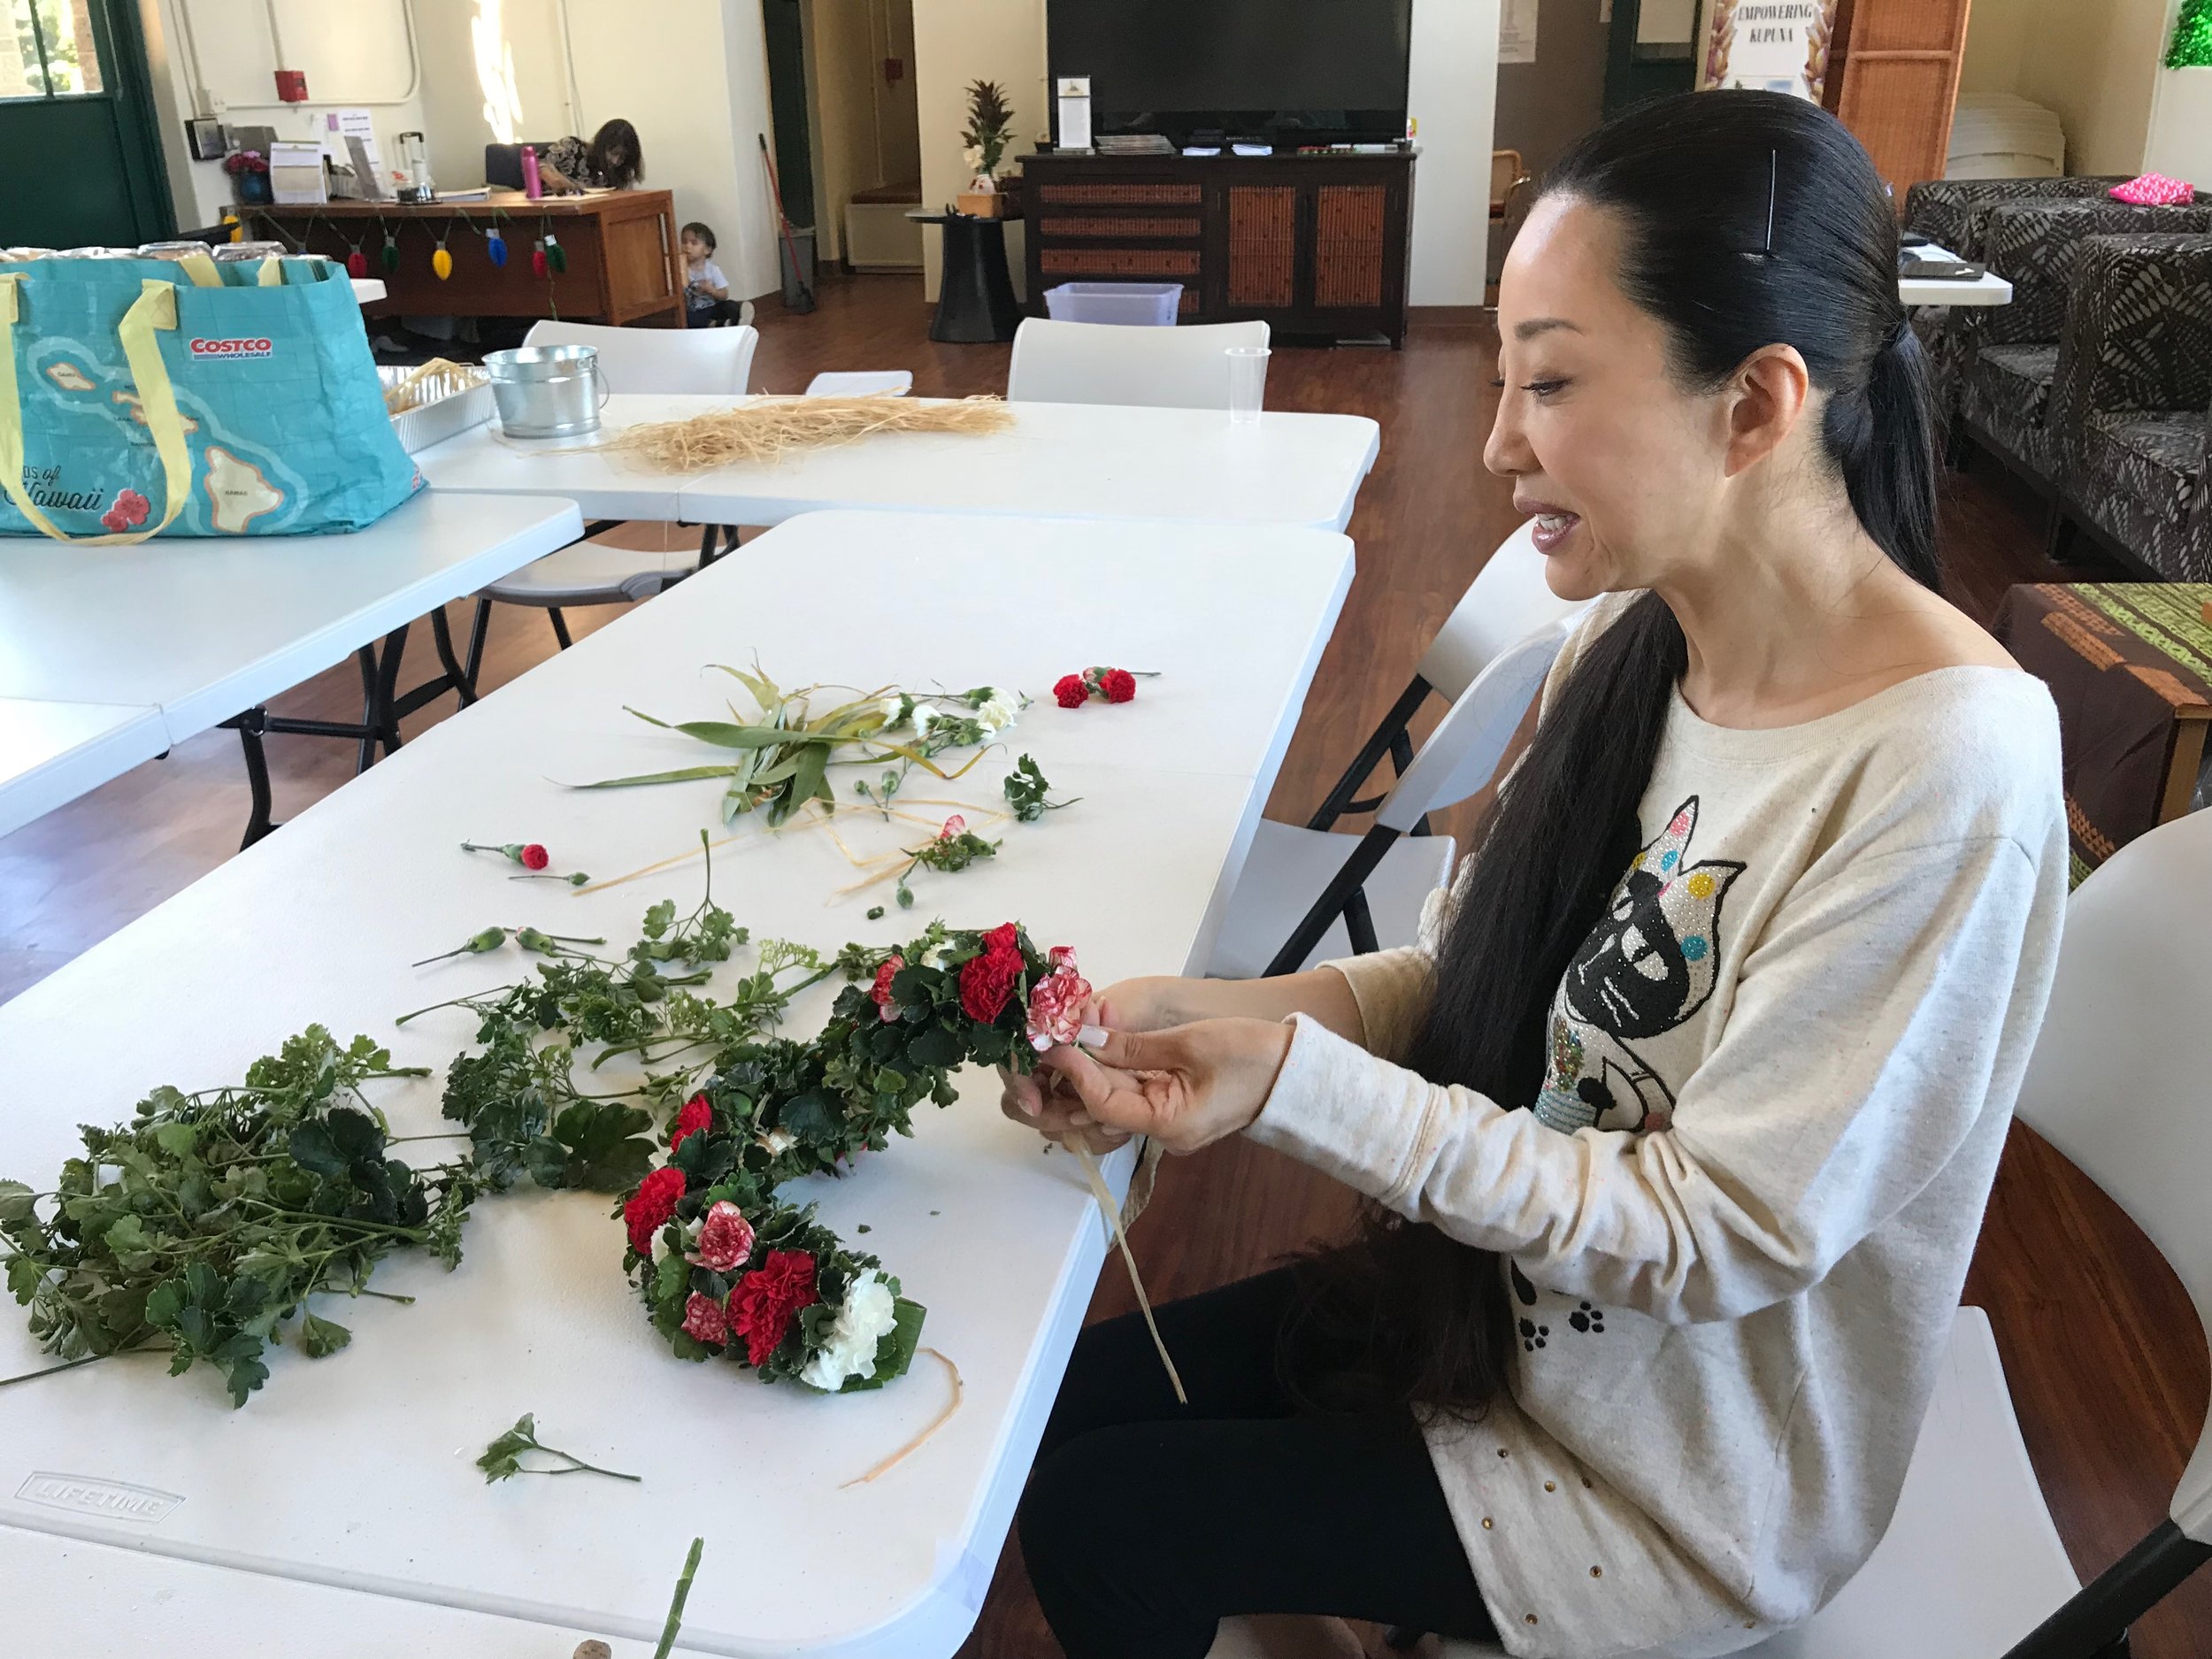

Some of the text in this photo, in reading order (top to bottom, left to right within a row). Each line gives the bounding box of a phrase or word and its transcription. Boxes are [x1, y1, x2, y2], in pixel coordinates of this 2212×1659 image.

[1738, 4, 1813, 20] EMPOWERING
[1750, 27, 1793, 42] KUPUNA
[190, 338, 273, 353] COSTCO
[42, 465, 62, 487] of
[35, 1479, 164, 1516] LIFETIME
